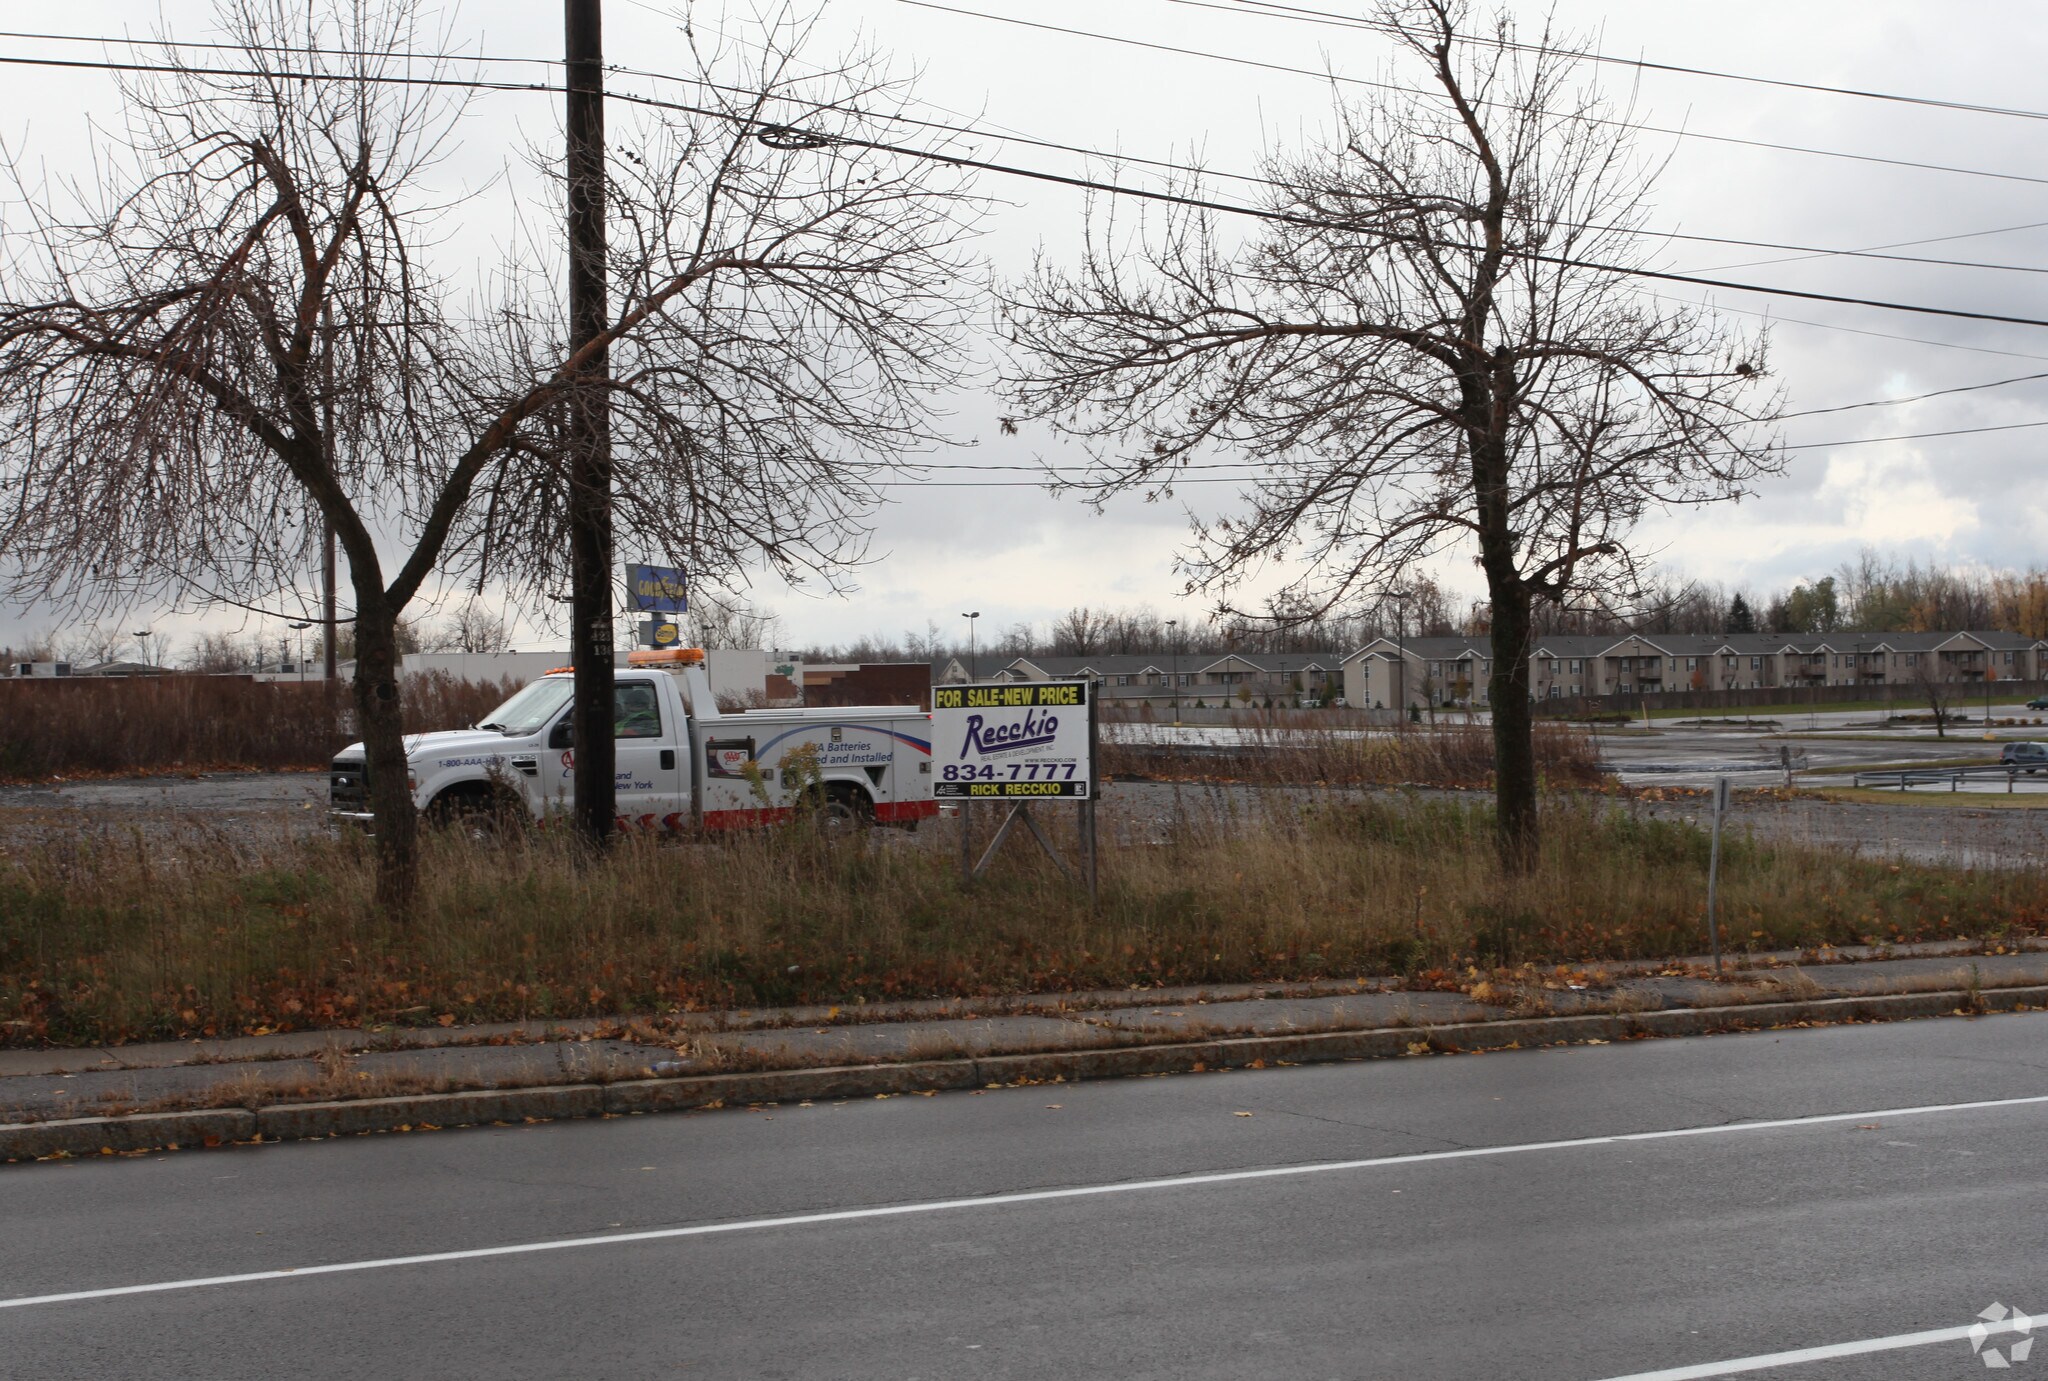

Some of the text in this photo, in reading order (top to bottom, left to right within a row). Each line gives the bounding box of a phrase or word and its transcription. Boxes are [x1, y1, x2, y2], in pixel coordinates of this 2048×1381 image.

[936, 690, 962, 707] FOR
[1039, 686, 1078, 705] PRICE
[960, 708, 1058, 760] Recckio
[827, 742, 871, 752] Batteries
[438, 756, 506, 768] 1-800-AAA-HEP
[830, 754, 849, 763] and
[851, 752, 893, 763] Installed
[943, 764, 1077, 781] 834-7777
[634, 781, 653, 789] York
[970, 784, 1000, 795] RICK
[1005, 783, 1061, 795] RECCKIO
